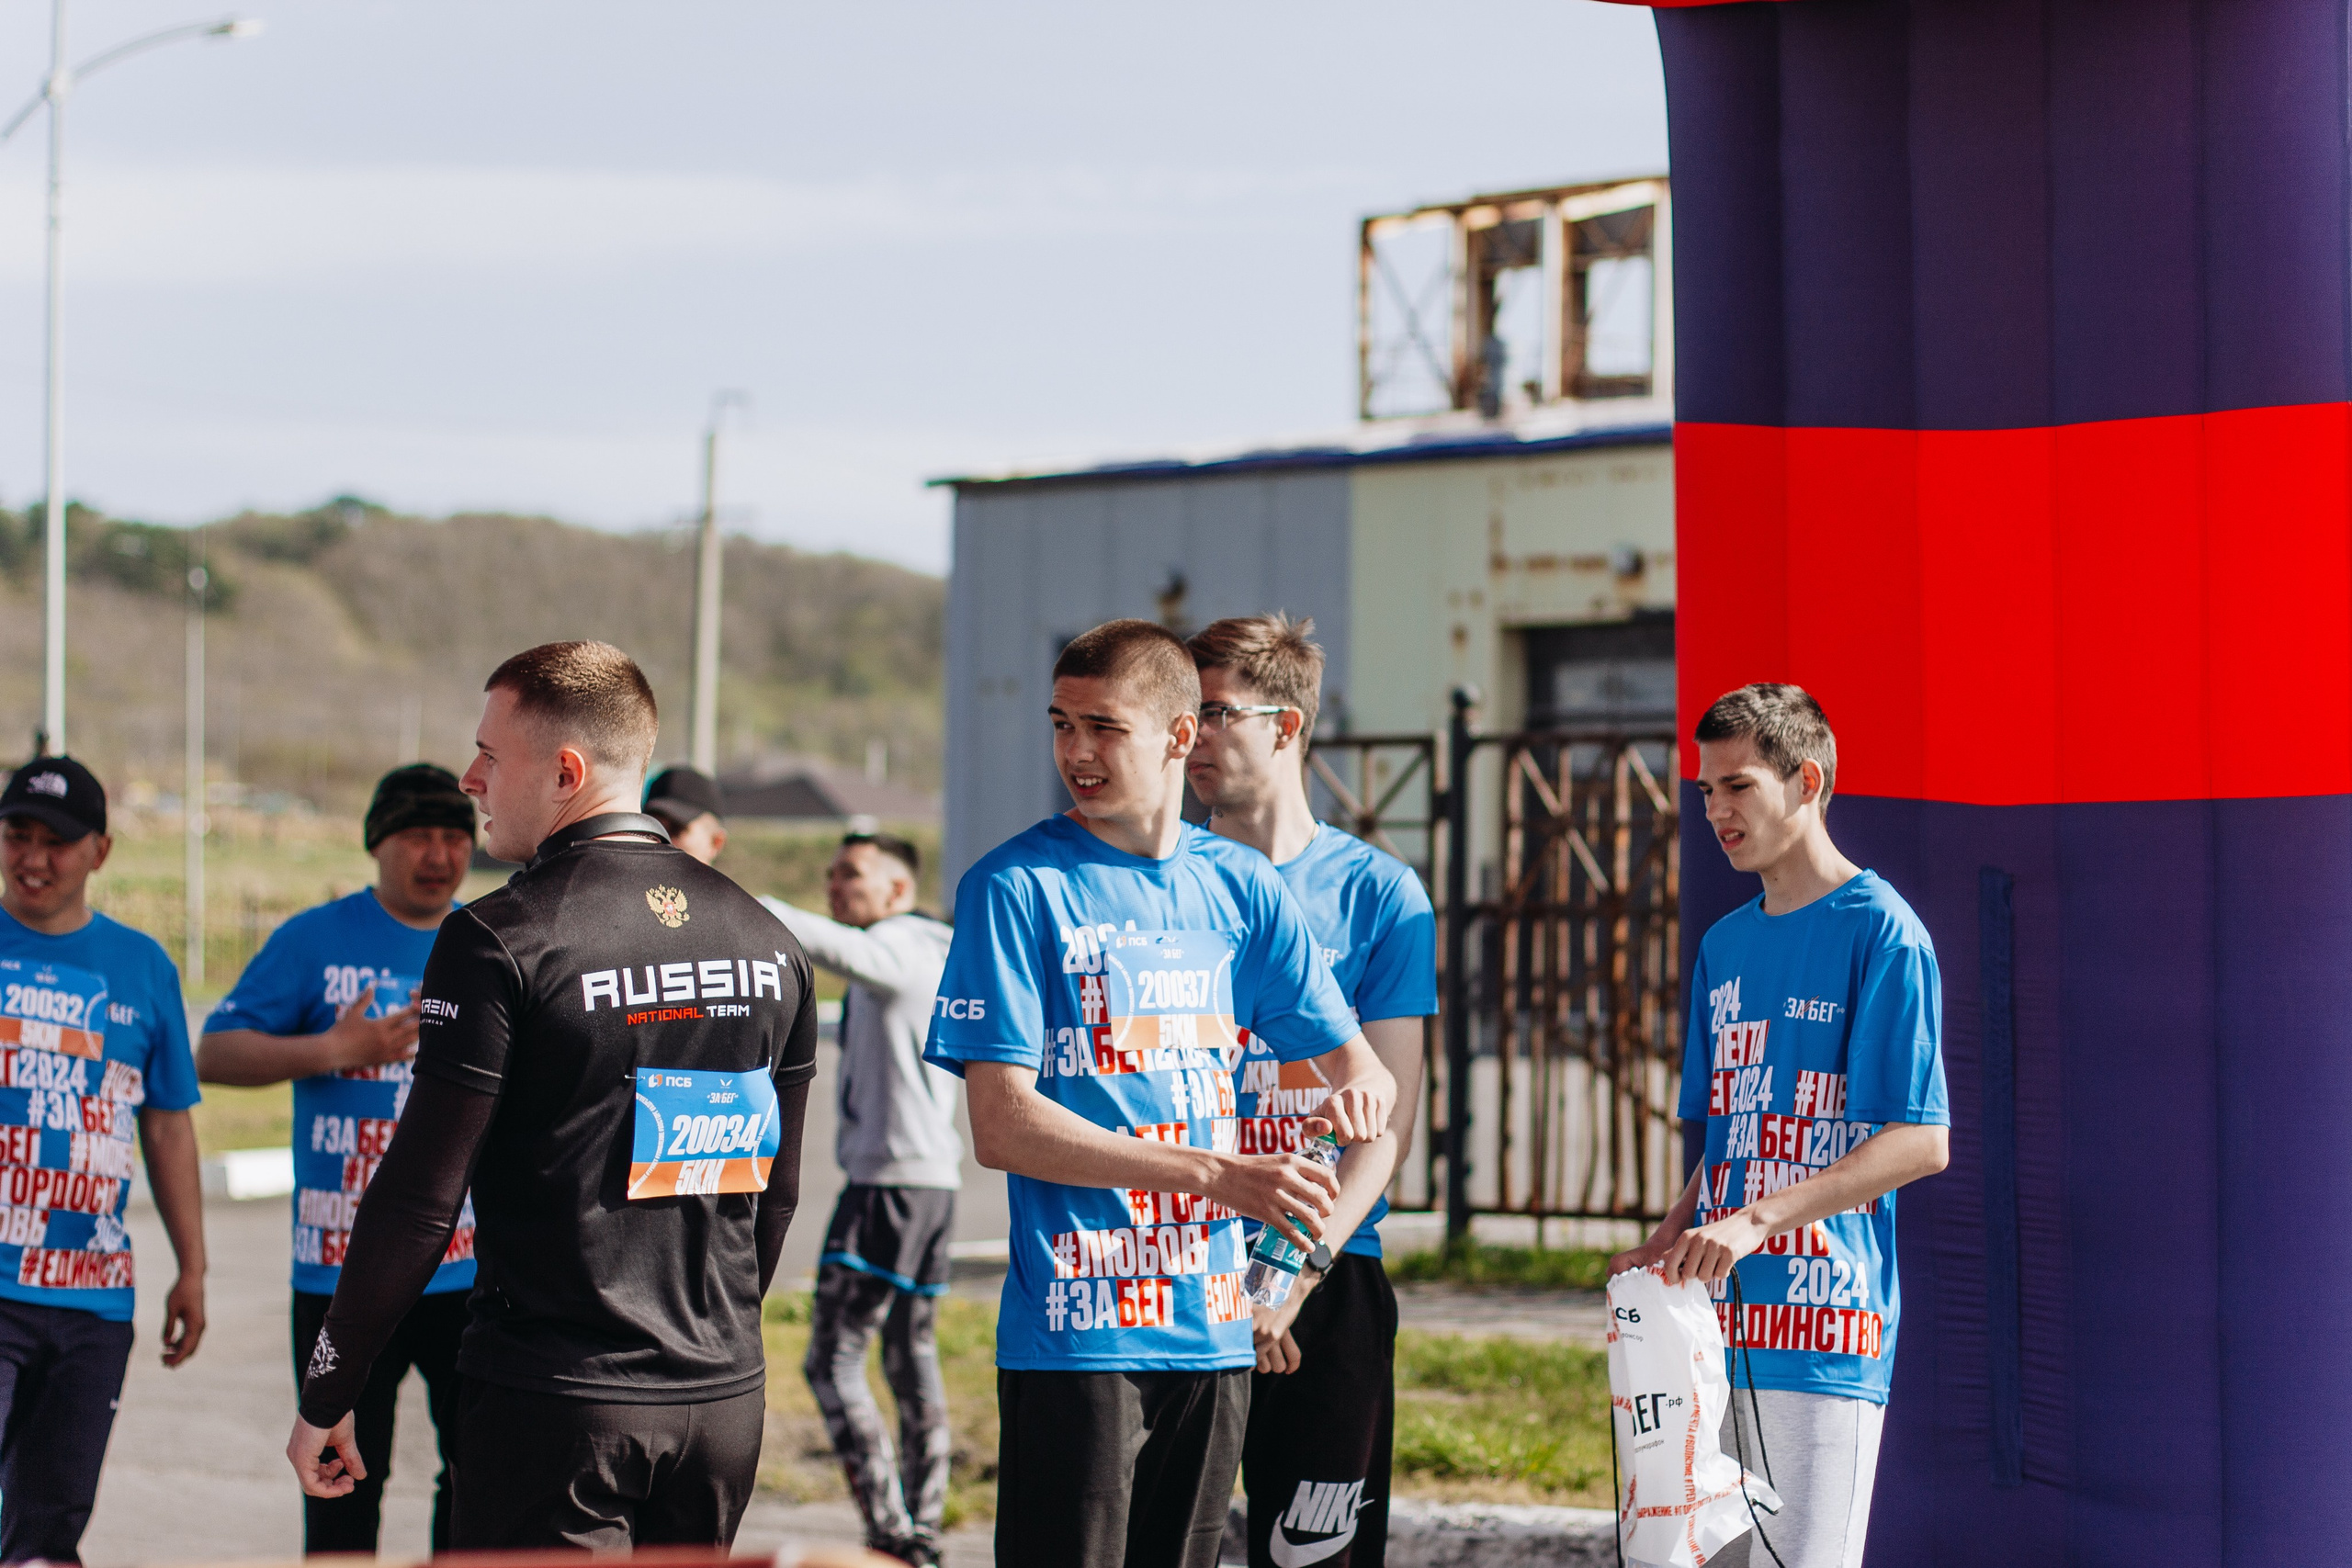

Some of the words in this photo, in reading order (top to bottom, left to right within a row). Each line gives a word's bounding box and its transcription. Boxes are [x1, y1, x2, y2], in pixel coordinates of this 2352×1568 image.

[1128, 937, 1148, 947] ПСБ
[5, 983, 85, 1027] 20032
[581, 959, 782, 1012] RUSSIA
[1137, 969, 1211, 1009] 20037
[626, 1007, 705, 1026] NATIONAL
[706, 1004, 750, 1019] TEAM
[932, 995, 986, 1021] ПСБ
[665, 1077, 693, 1088] ПСБ
[667, 1113, 762, 1156] 20034
[1053, 1224, 1210, 1279] #ЛЮБОВЬ
[1787, 1258, 1870, 1309] 2024
[1046, 1278, 1174, 1332] #ЗАБЕГ
[1615, 1307, 1641, 1323] СБ
